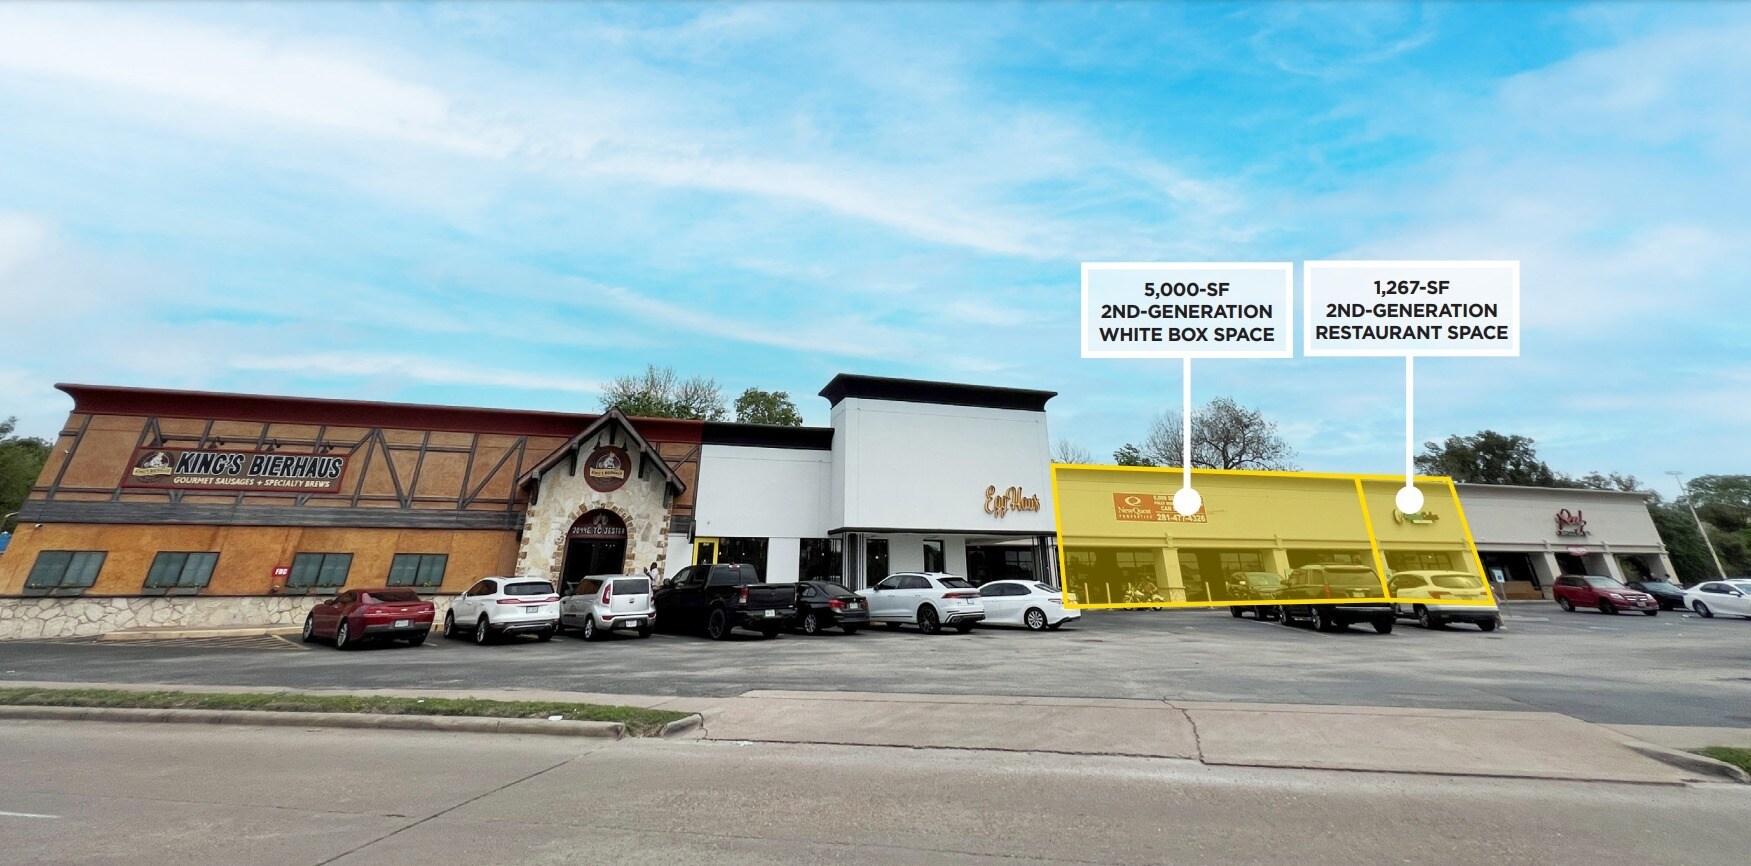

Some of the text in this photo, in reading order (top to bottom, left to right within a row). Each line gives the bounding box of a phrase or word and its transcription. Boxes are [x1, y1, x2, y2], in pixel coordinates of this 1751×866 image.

[174, 451, 343, 478] KING'S BIERHAUS
[173, 476, 215, 485] GOURMET
[215, 477, 254, 486] SAUSAGES
[264, 479, 303, 487] SPECIALTY
[304, 480, 331, 488] BREWS
[984, 484, 1041, 519] Egg Haus
